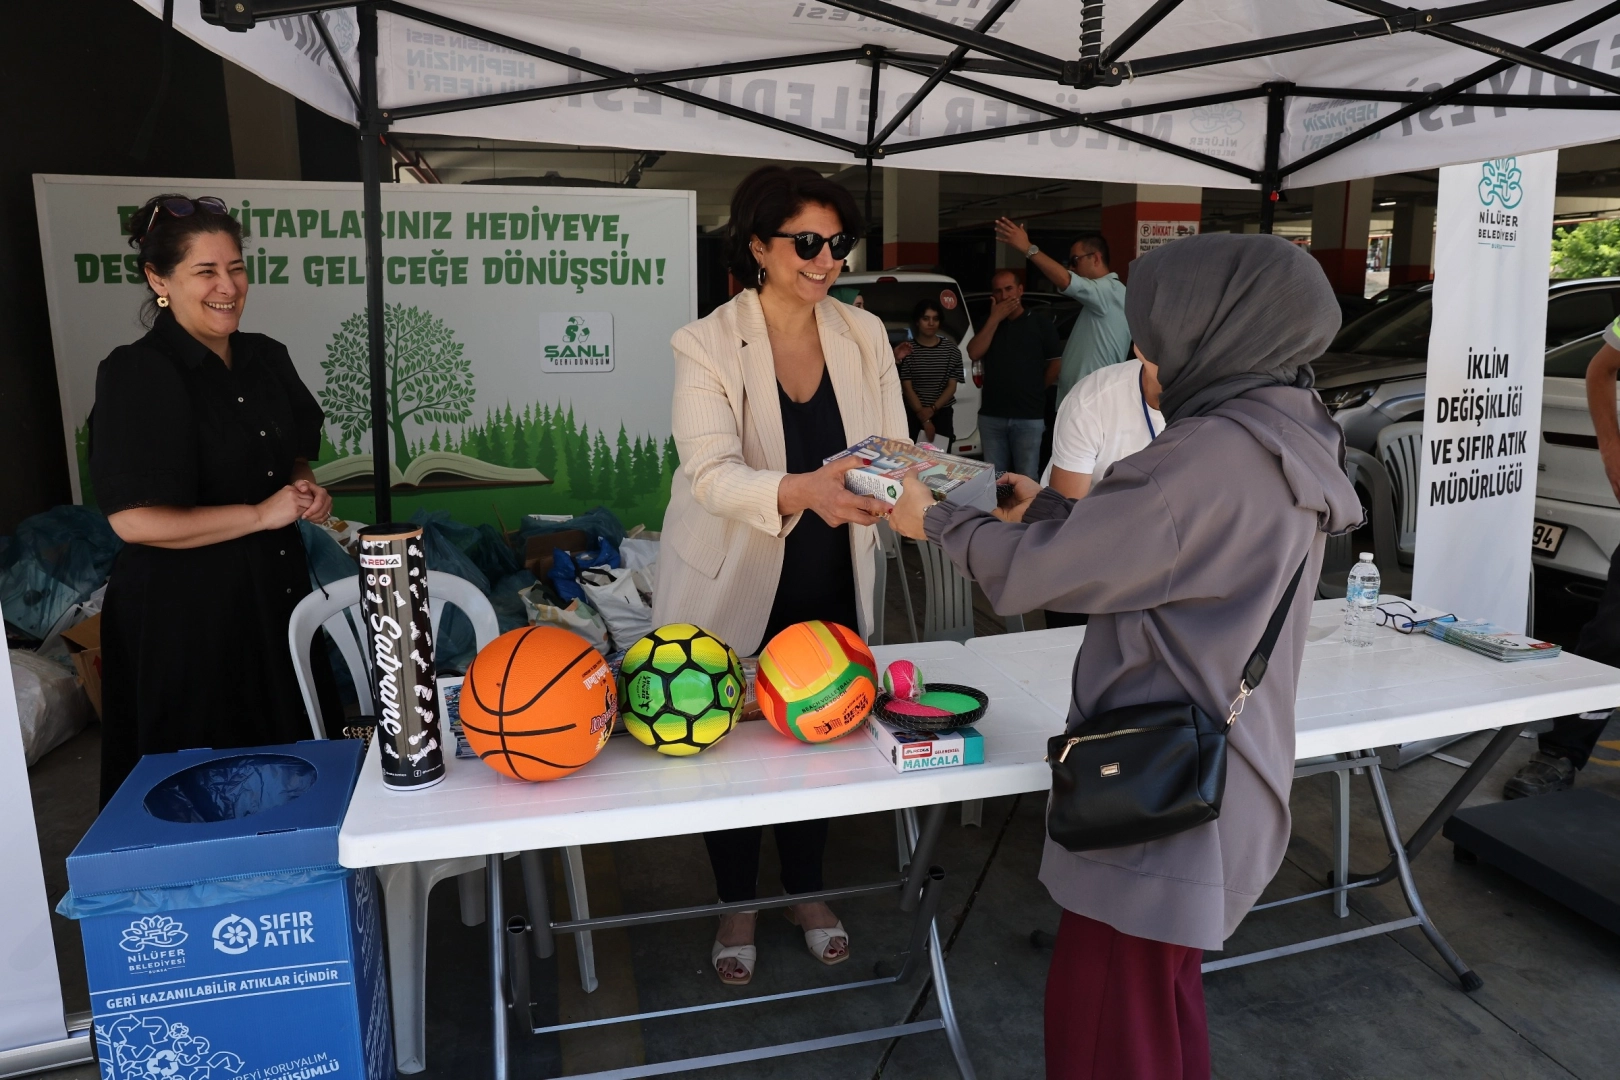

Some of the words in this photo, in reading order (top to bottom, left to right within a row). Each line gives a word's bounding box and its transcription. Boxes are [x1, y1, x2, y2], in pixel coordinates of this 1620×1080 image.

[466, 205, 630, 249] HEDİYEYE,
[1479, 208, 1519, 228] NİLÜFER
[1478, 228, 1517, 242] BELEDİYESİ
[303, 248, 469, 287] GELCEĞE
[482, 248, 666, 294] DÖNÜŞSÜN!
[544, 345, 609, 363] ŞANLI
[1467, 346, 1509, 380] İKLİM
[1436, 385, 1523, 427] DEĞİŞİKLİĞİ
[1430, 438, 1453, 466] VE
[1456, 434, 1495, 463] SIFIR
[1497, 430, 1528, 458] ATIK
[1430, 461, 1523, 507] MÜDÜRLÜĞÜ
[368, 558, 400, 566] REDKA
[370, 612, 403, 736] Satranç
[801, 701, 821, 713] BEACH
[821, 678, 852, 703] VOLLEYBALL
[903, 755, 960, 770] MANCALA
[259, 910, 314, 931] SIFIR
[263, 927, 315, 948] ATIK
[127, 948, 186, 963] NİLÜFER
[128, 956, 186, 971] BELEDİYESİ
[106, 992, 137, 1009] GERİ
[140, 980, 237, 1005] KAZANILABİLİR
[239, 975, 291, 991] ATIKLAR
[293, 968, 339, 986] İÇİNDİR
[263, 1052, 328, 1077] KORUYALIM
